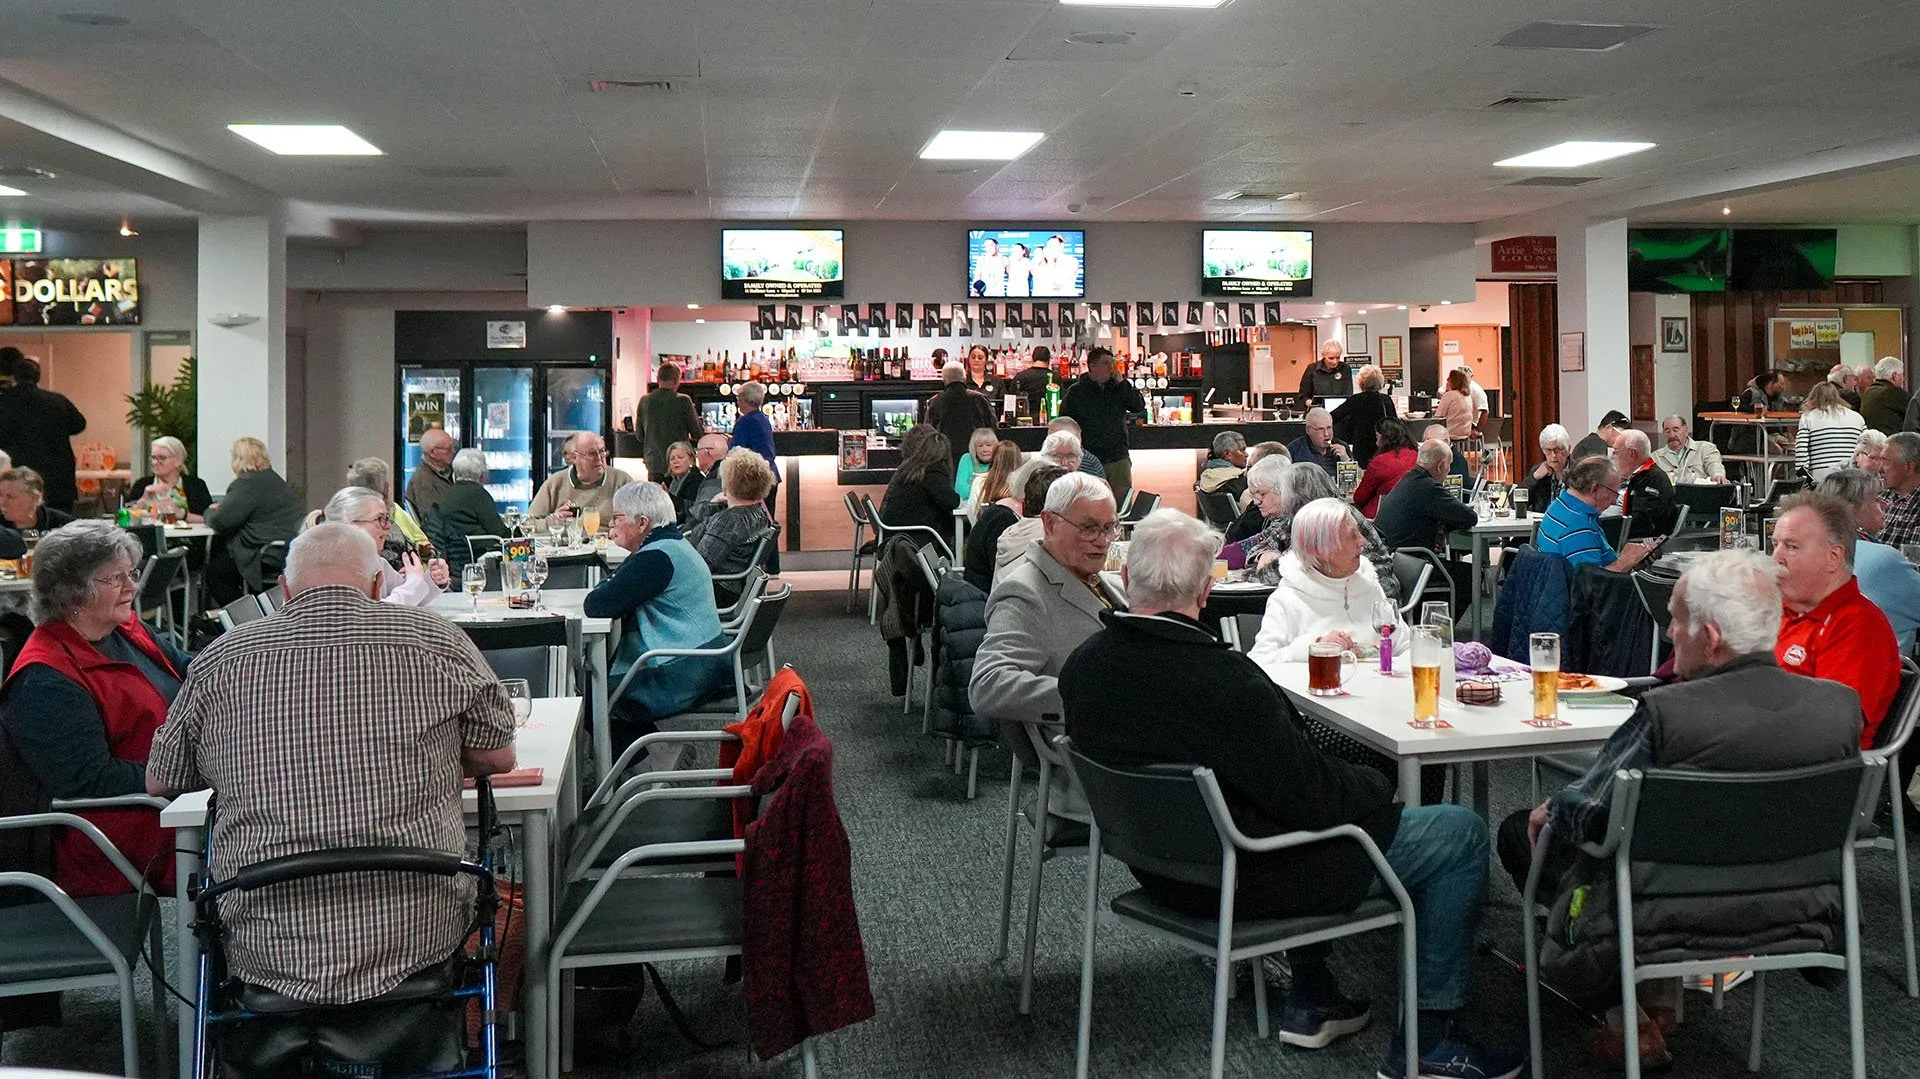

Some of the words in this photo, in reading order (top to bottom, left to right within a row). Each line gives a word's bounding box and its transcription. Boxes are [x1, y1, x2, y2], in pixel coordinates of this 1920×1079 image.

[1497, 244, 1525, 254] Artie
[15, 278, 138, 302] DOLLARS
[414, 400, 440, 412] WIN
